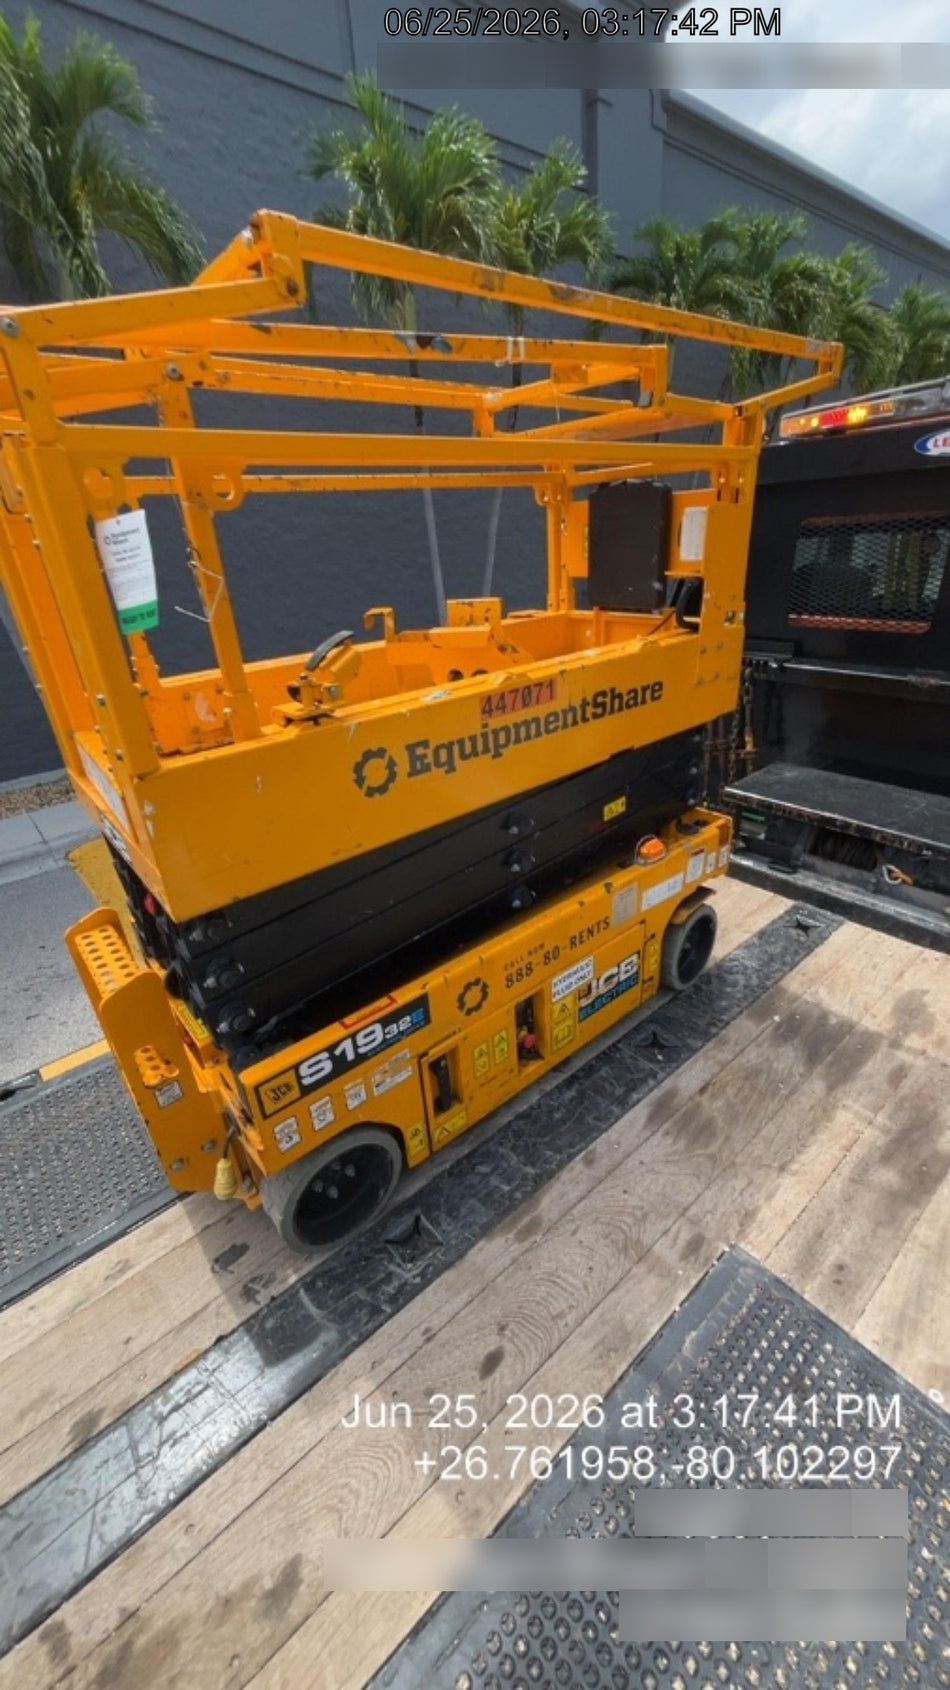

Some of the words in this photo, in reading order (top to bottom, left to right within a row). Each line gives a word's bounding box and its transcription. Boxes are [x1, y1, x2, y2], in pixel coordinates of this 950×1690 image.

[405, 680, 665, 779] EquipmentShare
[481, 679, 554, 718] 447071
[504, 915, 611, 990] 888-80-RENTS
